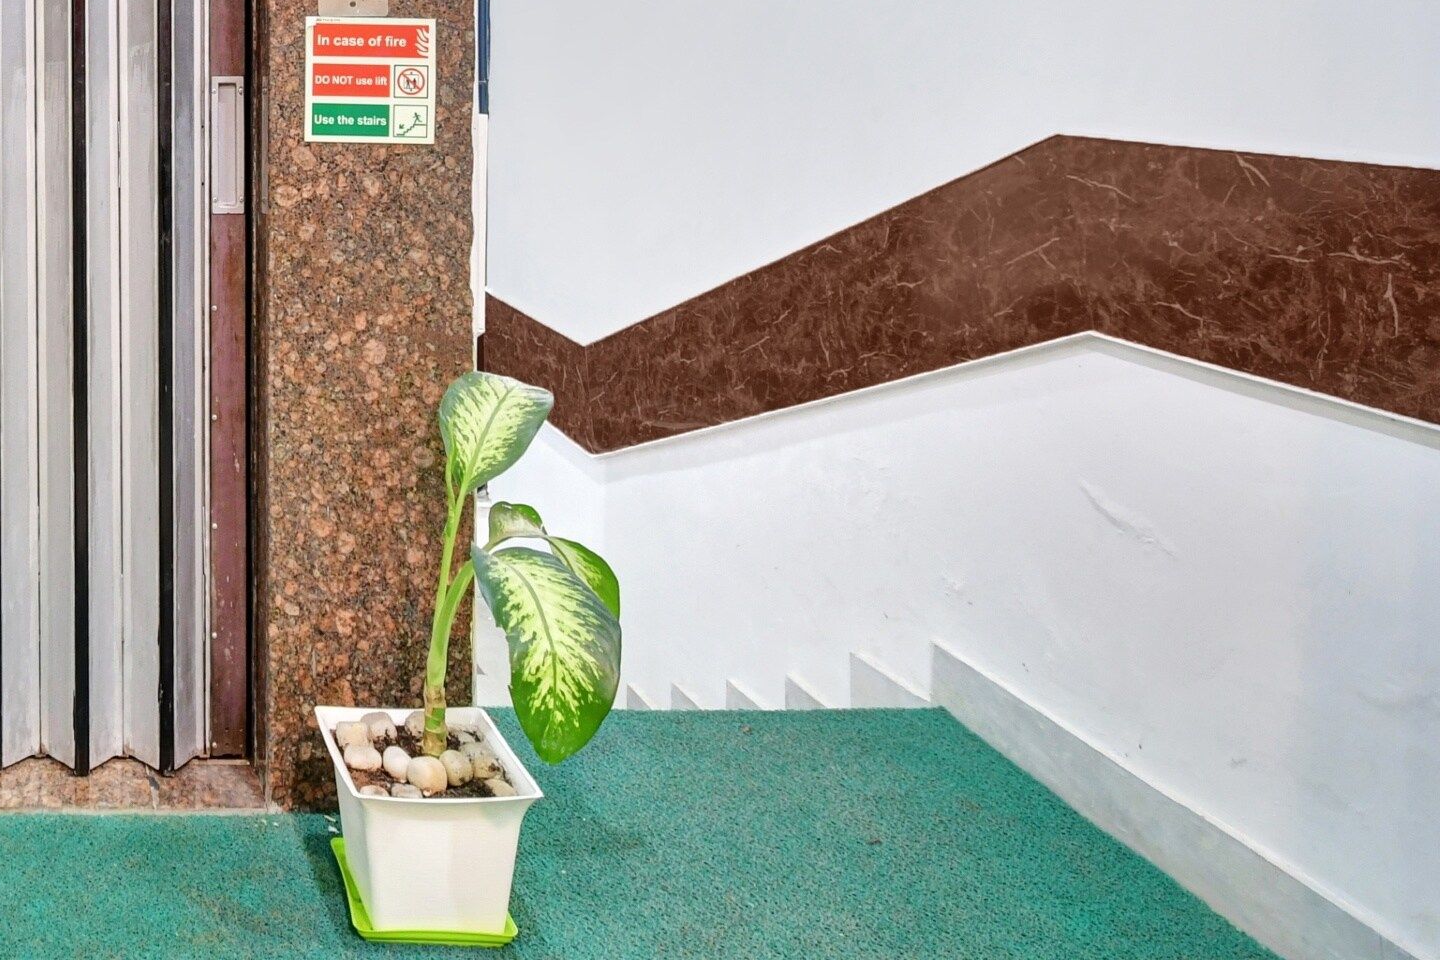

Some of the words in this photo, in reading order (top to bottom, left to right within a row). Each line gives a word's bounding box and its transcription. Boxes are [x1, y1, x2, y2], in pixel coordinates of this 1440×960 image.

[317, 34, 330, 46] In
[332, 37, 365, 47] case
[367, 35, 382, 47] of
[384, 35, 407, 48] fire
[314, 75, 330, 85] DO
[331, 75, 353, 85] NOT
[355, 77, 373, 86] use
[375, 76, 388, 86] lift
[314, 114, 335, 125] Use
[337, 115, 355, 125] the
[357, 115, 388, 126] stairs
